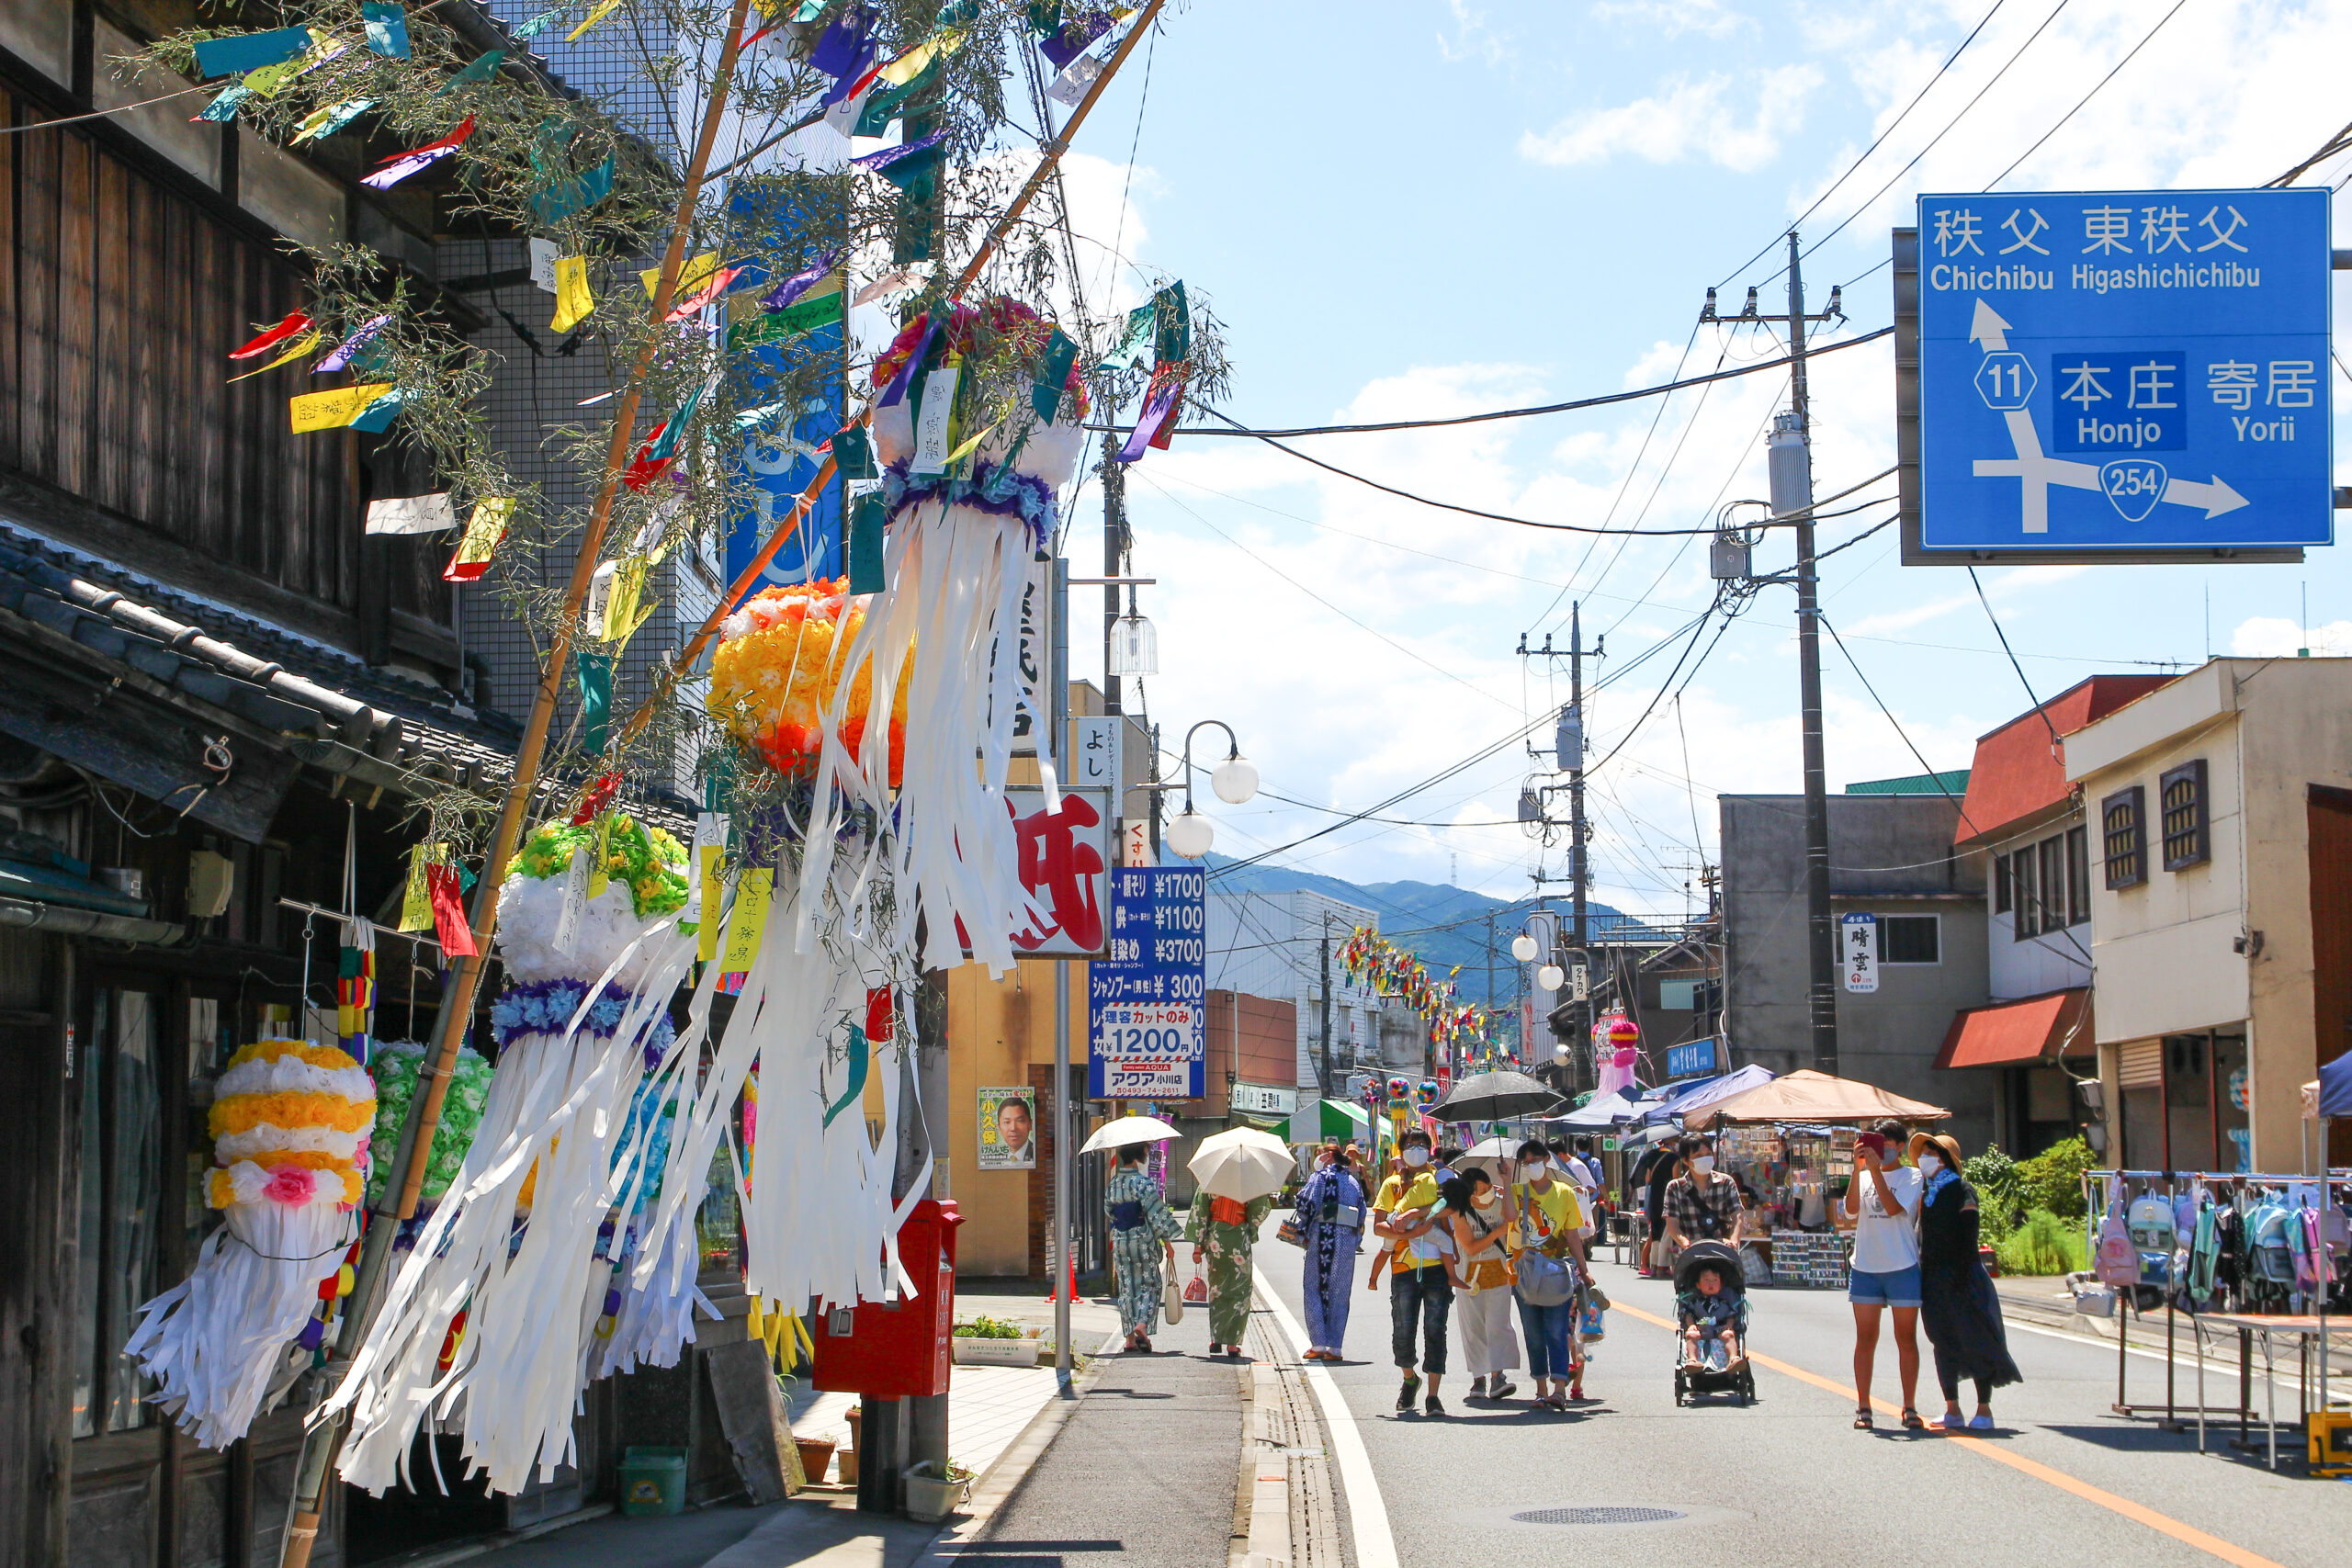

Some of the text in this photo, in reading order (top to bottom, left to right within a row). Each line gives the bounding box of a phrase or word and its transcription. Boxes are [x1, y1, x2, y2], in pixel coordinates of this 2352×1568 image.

[1934, 205, 2248, 256] 秩父 東秩父
[1931, 262, 2260, 294] Chichibu Higashichichibu
[1988, 364, 2020, 398] 11
[2061, 360, 2177, 411] 本庄
[2207, 359, 2317, 410] 寄居
[2078, 418, 2161, 448] Honjo
[2232, 416, 2294, 441] Yorii
[2110, 468, 2157, 495] 254
[1155, 874, 1203, 898] ¥1700
[1155, 906, 1203, 930] ¥1100
[1155, 939, 1203, 962] ¥3700
[1851, 927, 1870, 972] 晴雲
[1576, 967, 1584, 995] タケカワ
[981, 1100, 996, 1145] 小久保
[981, 1145, 1009, 1155] けんいち
